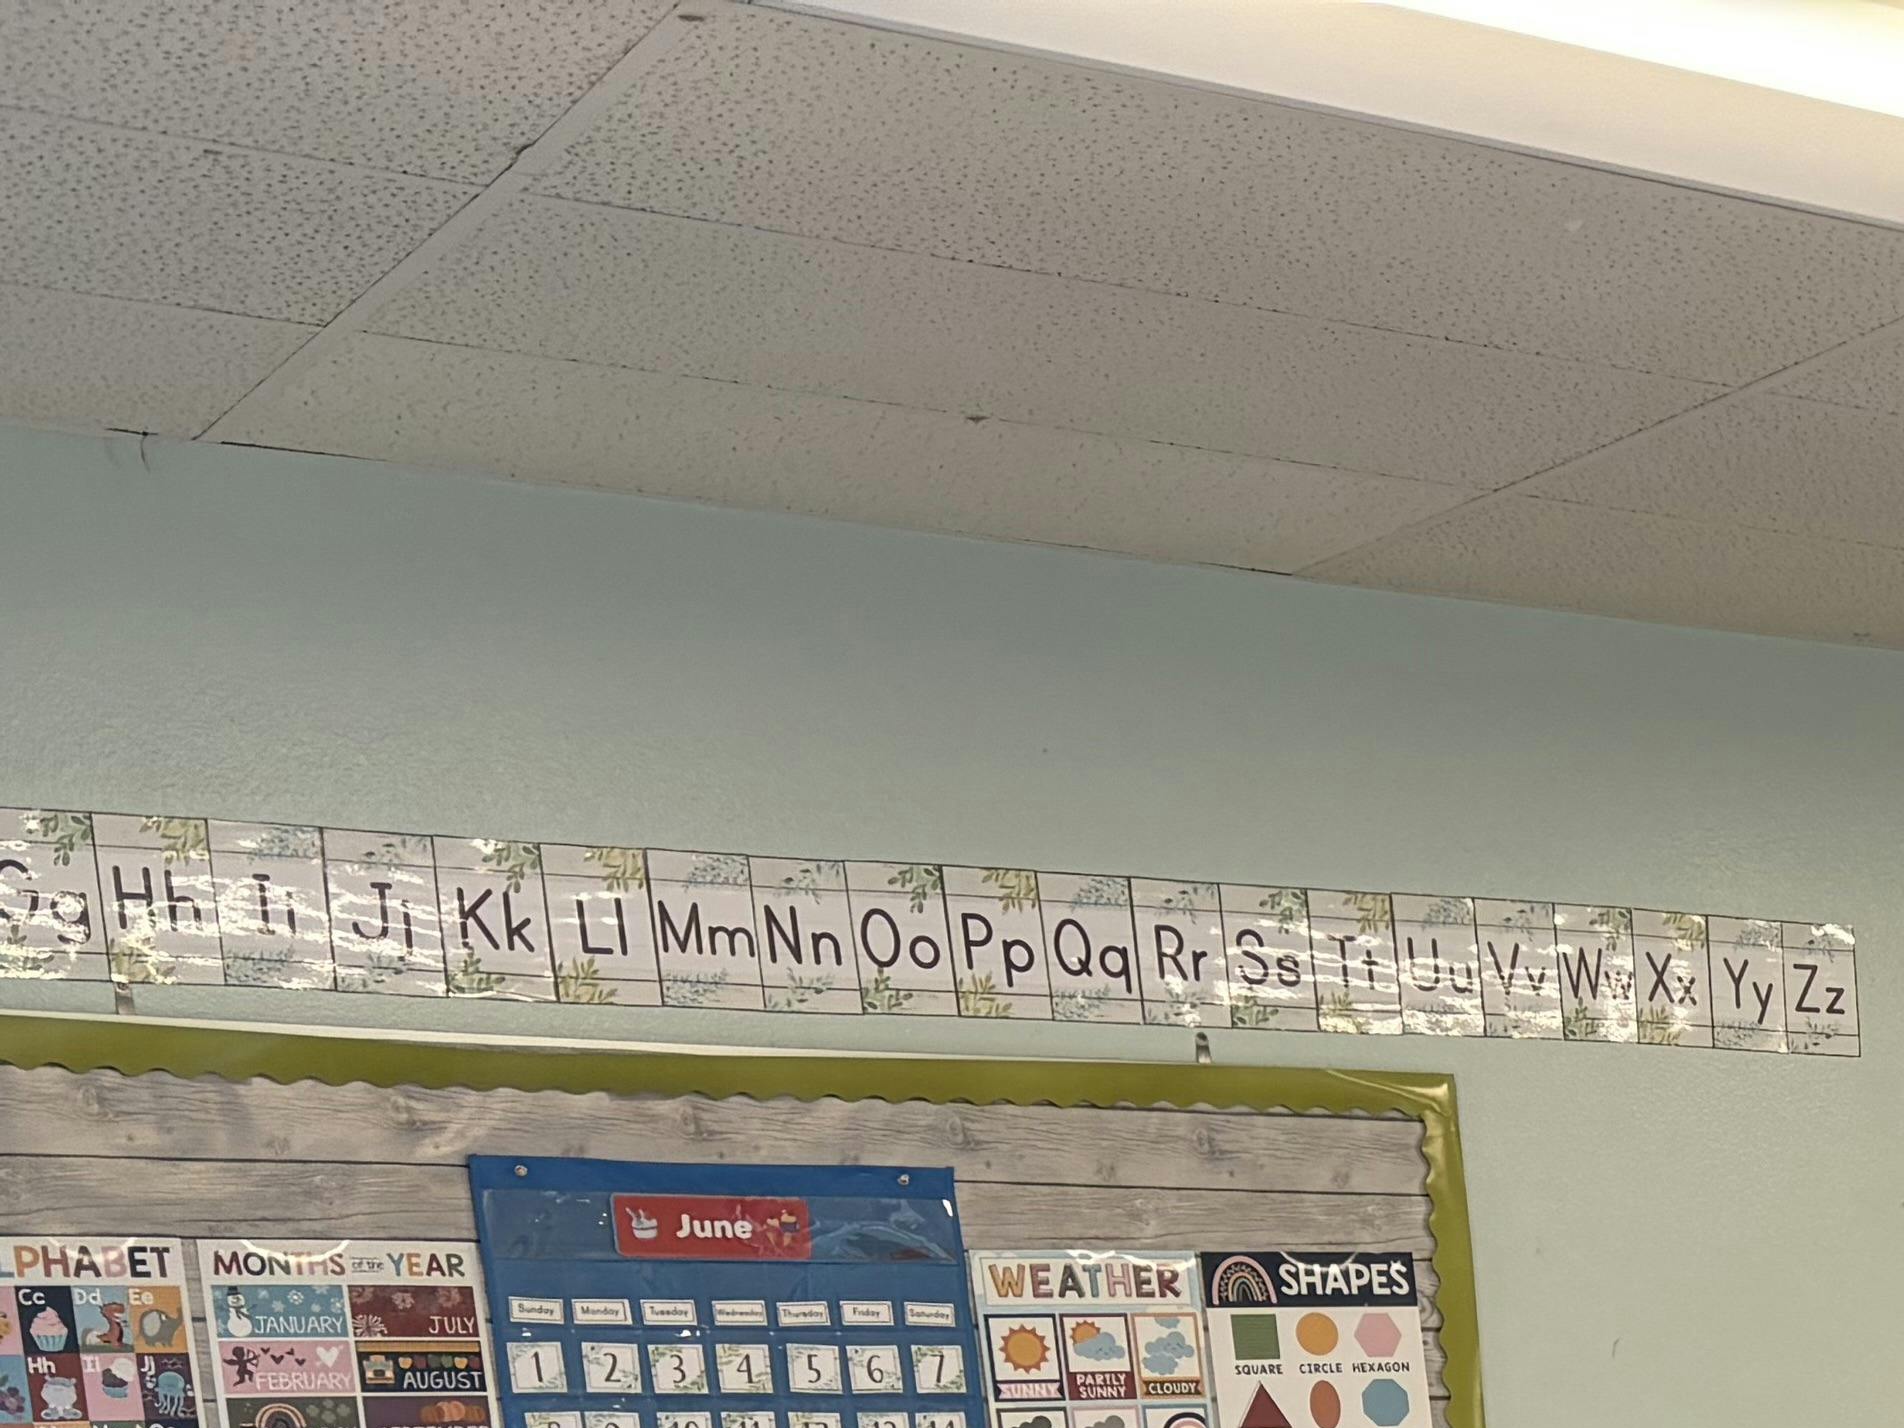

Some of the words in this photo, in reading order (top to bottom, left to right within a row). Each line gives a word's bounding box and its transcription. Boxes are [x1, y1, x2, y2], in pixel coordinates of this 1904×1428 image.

[112, 865, 201, 932] Hh
[457, 887, 534, 952] Kk
[576, 898, 628, 955] Ll
[659, 901, 754, 957] Mm
[764, 904, 841, 965] Nn
[861, 908, 940, 967] Oo
[961, 913, 1035, 987] Pp
[1054, 918, 1132, 994] Qq
[1155, 924, 1207, 981] Rr
[1236, 928, 1300, 986] Ss
[1407, 938, 1473, 993] Uu
[1487, 941, 1547, 996] Vv
[1563, 948, 1632, 1000] Ww
[1646, 952, 1696, 1005] Xx
[1724, 958, 1773, 1024] Yy
[1793, 964, 1844, 1014] Zz
[676, 1214, 753, 1239] June
[214, 1251, 346, 1276] MONTHS
[387, 1253, 465, 1278] YEAR
[988, 1263, 1182, 1298] WEATHER
[1279, 1262, 1410, 1296] SHAPES
[518, 1303, 554, 1316] Sunday
[581, 1305, 619, 1317] Monday
[852, 1308, 880, 1319] Friday
[255, 1316, 343, 1334] JANUARY
[428, 1316, 475, 1334] JULY
[28, 1358, 56, 1373] Hh
[531, 1351, 543, 1382] 1
[604, 1353, 621, 1382] 2
[670, 1354, 686, 1383] 3
[737, 1353, 753, 1384] 4
[807, 1354, 821, 1383] 5
[867, 1355, 883, 1383] 6
[928, 1354, 944, 1383] 7
[1235, 1364, 1283, 1375] SQUARE
[1299, 1363, 1343, 1374] CIRCLE
[1352, 1362, 1410, 1373] HEXAGON
[255, 1372, 351, 1391] FEBRUARY
[403, 1372, 483, 1390] AUGUST
[1149, 1382, 1196, 1395] CLOUDY
[1080, 1386, 1127, 1399] SUNNY
